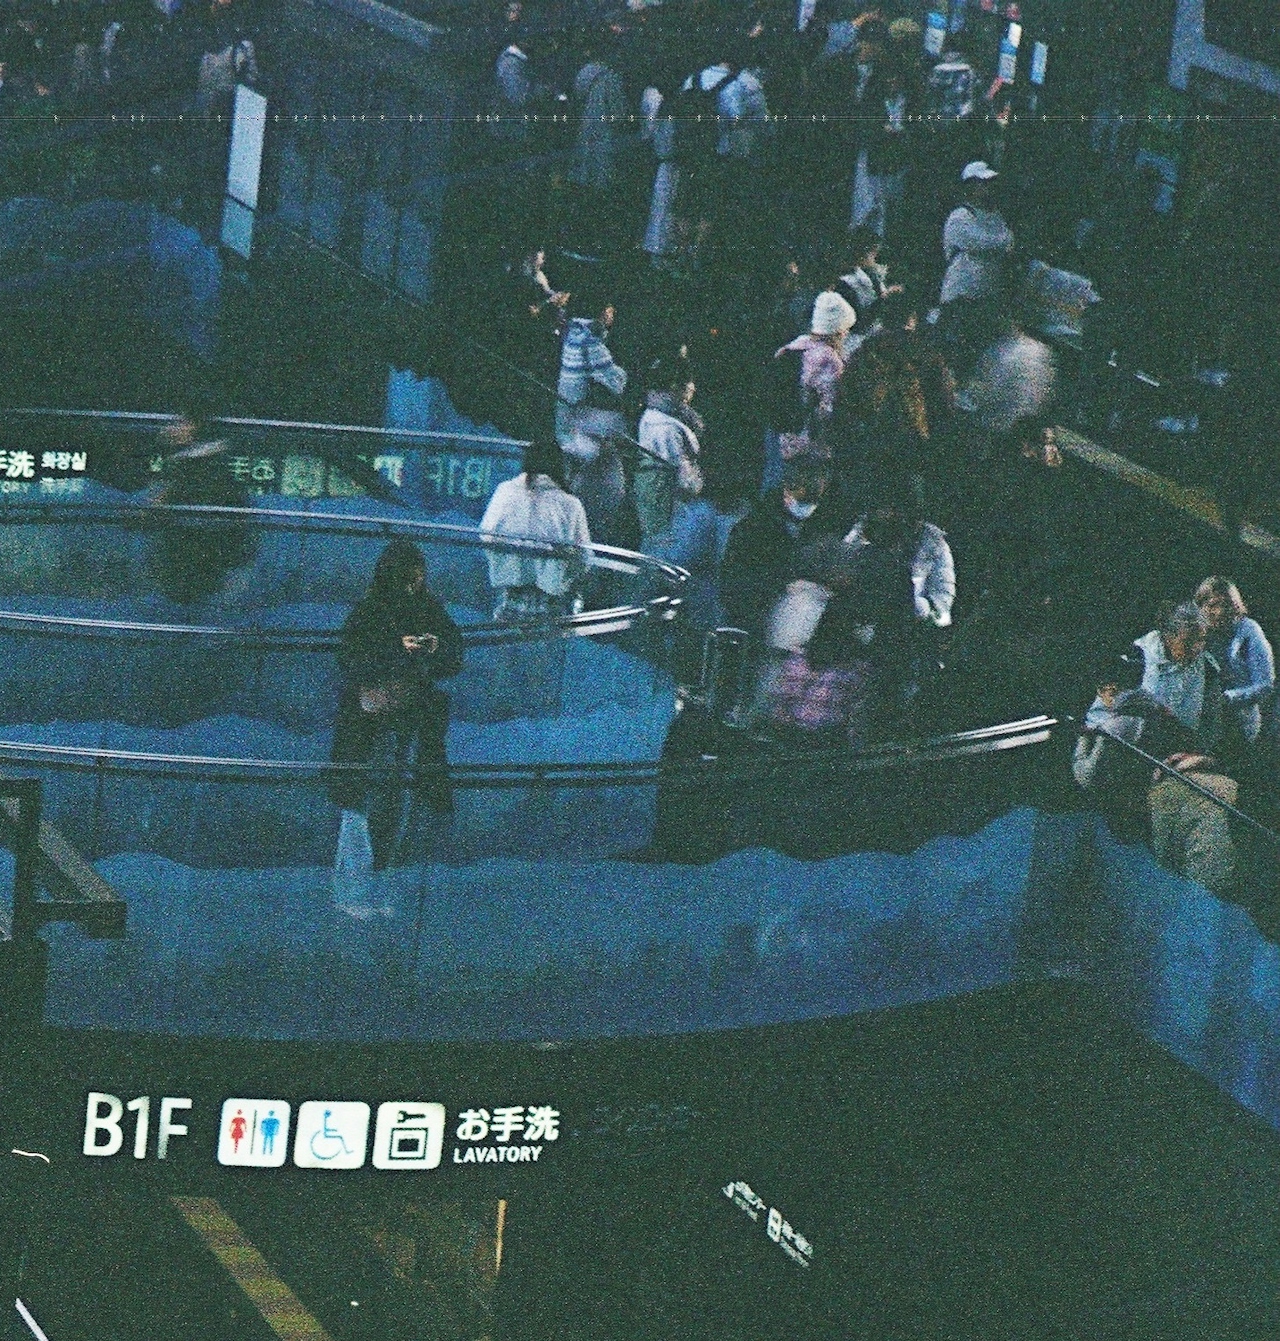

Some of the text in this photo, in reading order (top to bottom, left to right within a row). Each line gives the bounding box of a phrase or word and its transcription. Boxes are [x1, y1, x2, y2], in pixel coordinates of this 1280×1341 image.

[83, 1092, 193, 1160] B1F
[456, 1105, 560, 1142] お手洗
[453, 1146, 543, 1165] LAVATORY
